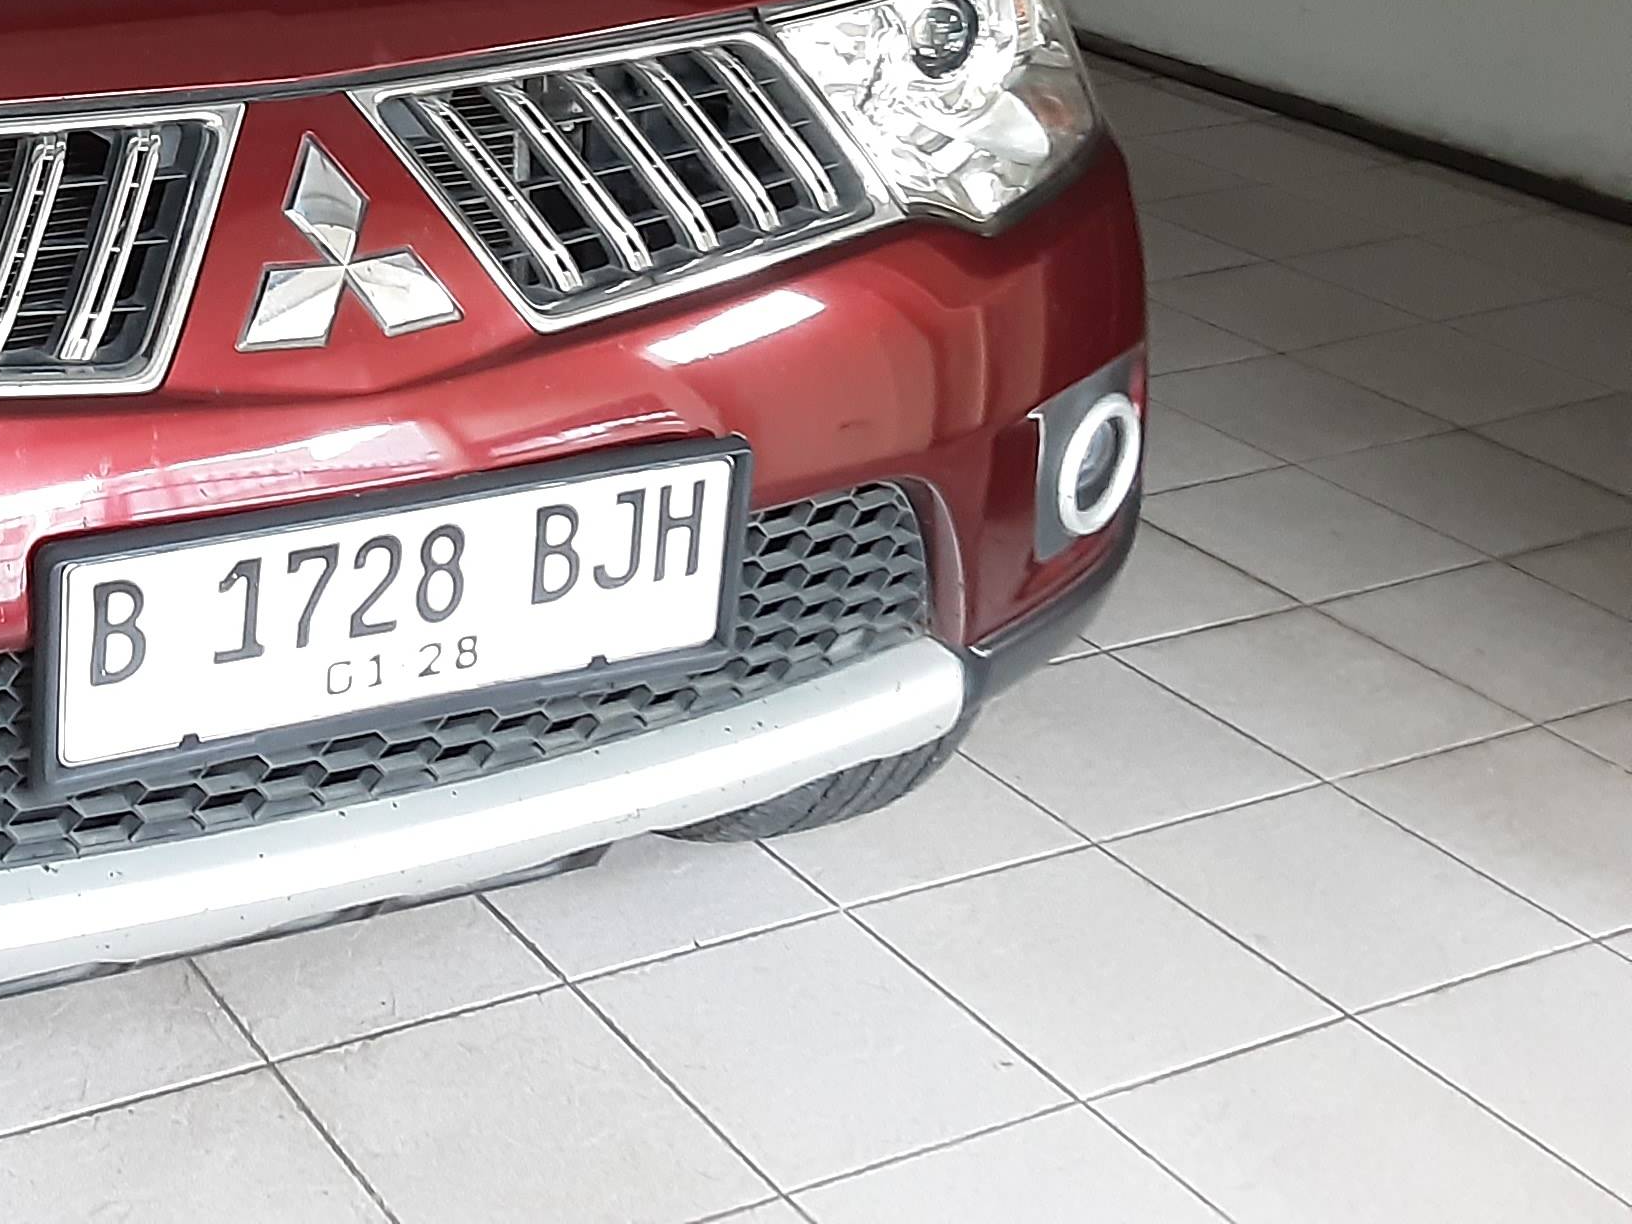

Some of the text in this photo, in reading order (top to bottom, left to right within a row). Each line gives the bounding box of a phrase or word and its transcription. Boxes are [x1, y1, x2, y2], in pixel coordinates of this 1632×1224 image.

[89, 479, 706, 686] B 1728 BJH
